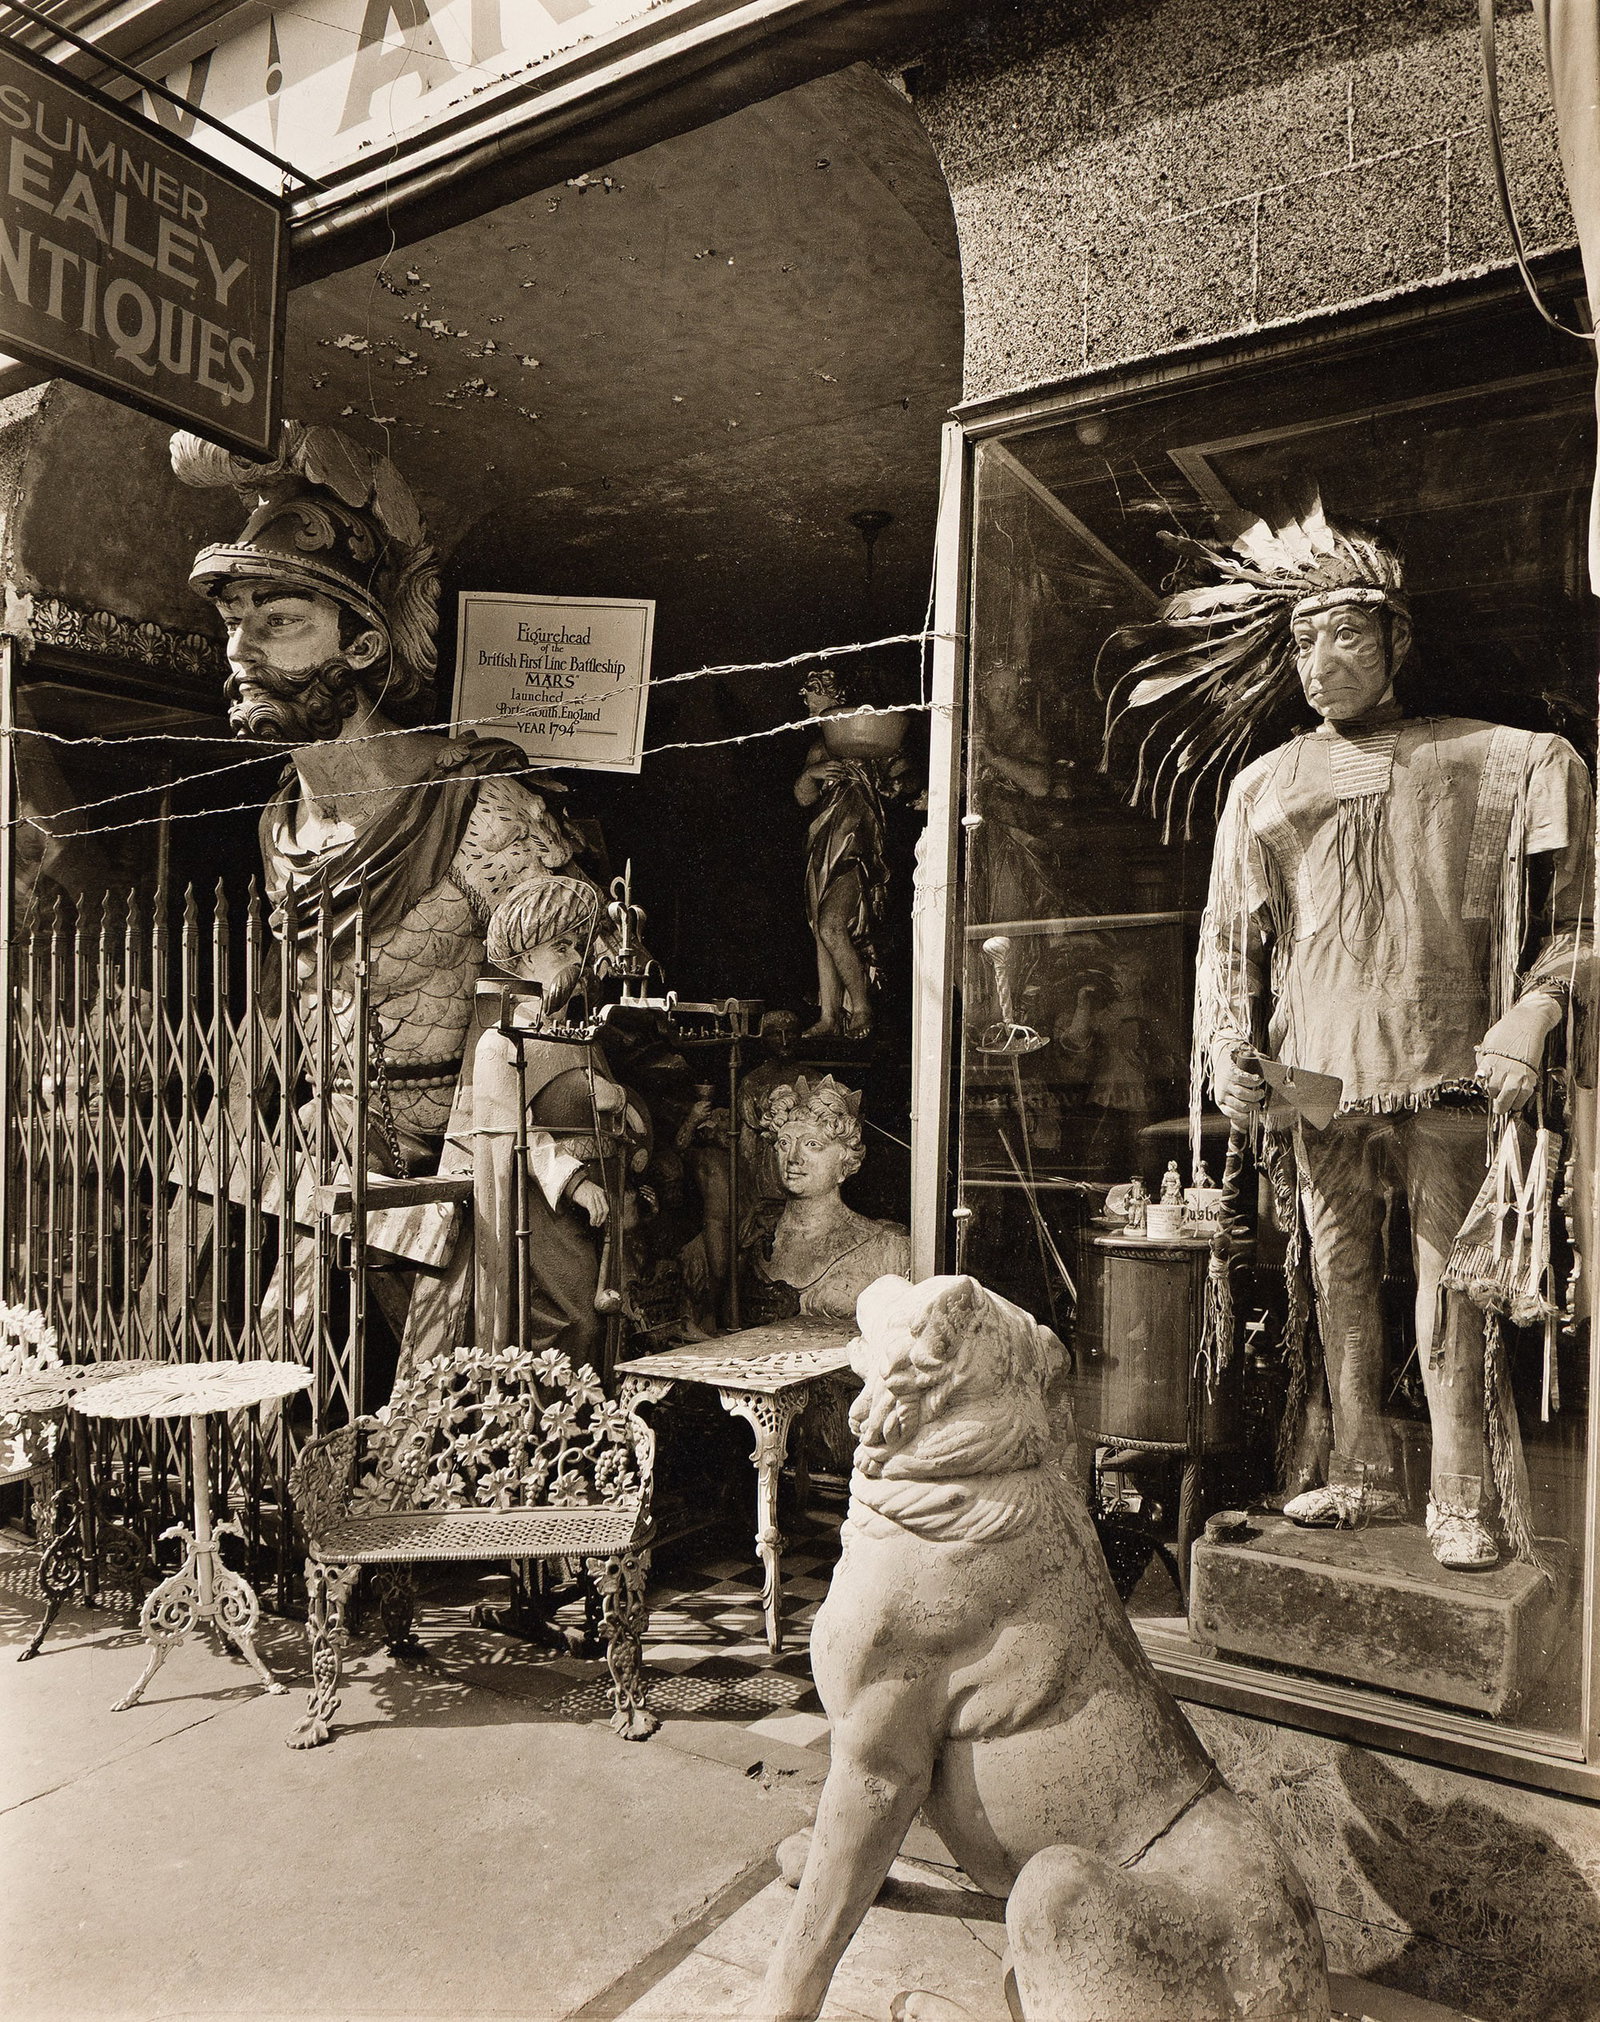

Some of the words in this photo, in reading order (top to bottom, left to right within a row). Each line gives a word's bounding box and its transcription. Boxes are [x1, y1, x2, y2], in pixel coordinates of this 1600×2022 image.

[0, 84, 208, 230] SUMNER
[516, 622, 591, 645] Figurehead
[540, 643, 551, 654] of
[551, 645, 564, 653] the
[478, 650, 517, 668] British
[519, 653, 544, 669] First
[544, 655, 567, 671] Line
[569, 656, 626, 682] Battleship
[511, 688, 563, 703] launched
[561, 706, 601, 725] England
[517, 722, 546, 734] YEAR
[549, 722, 575, 741] 1794
